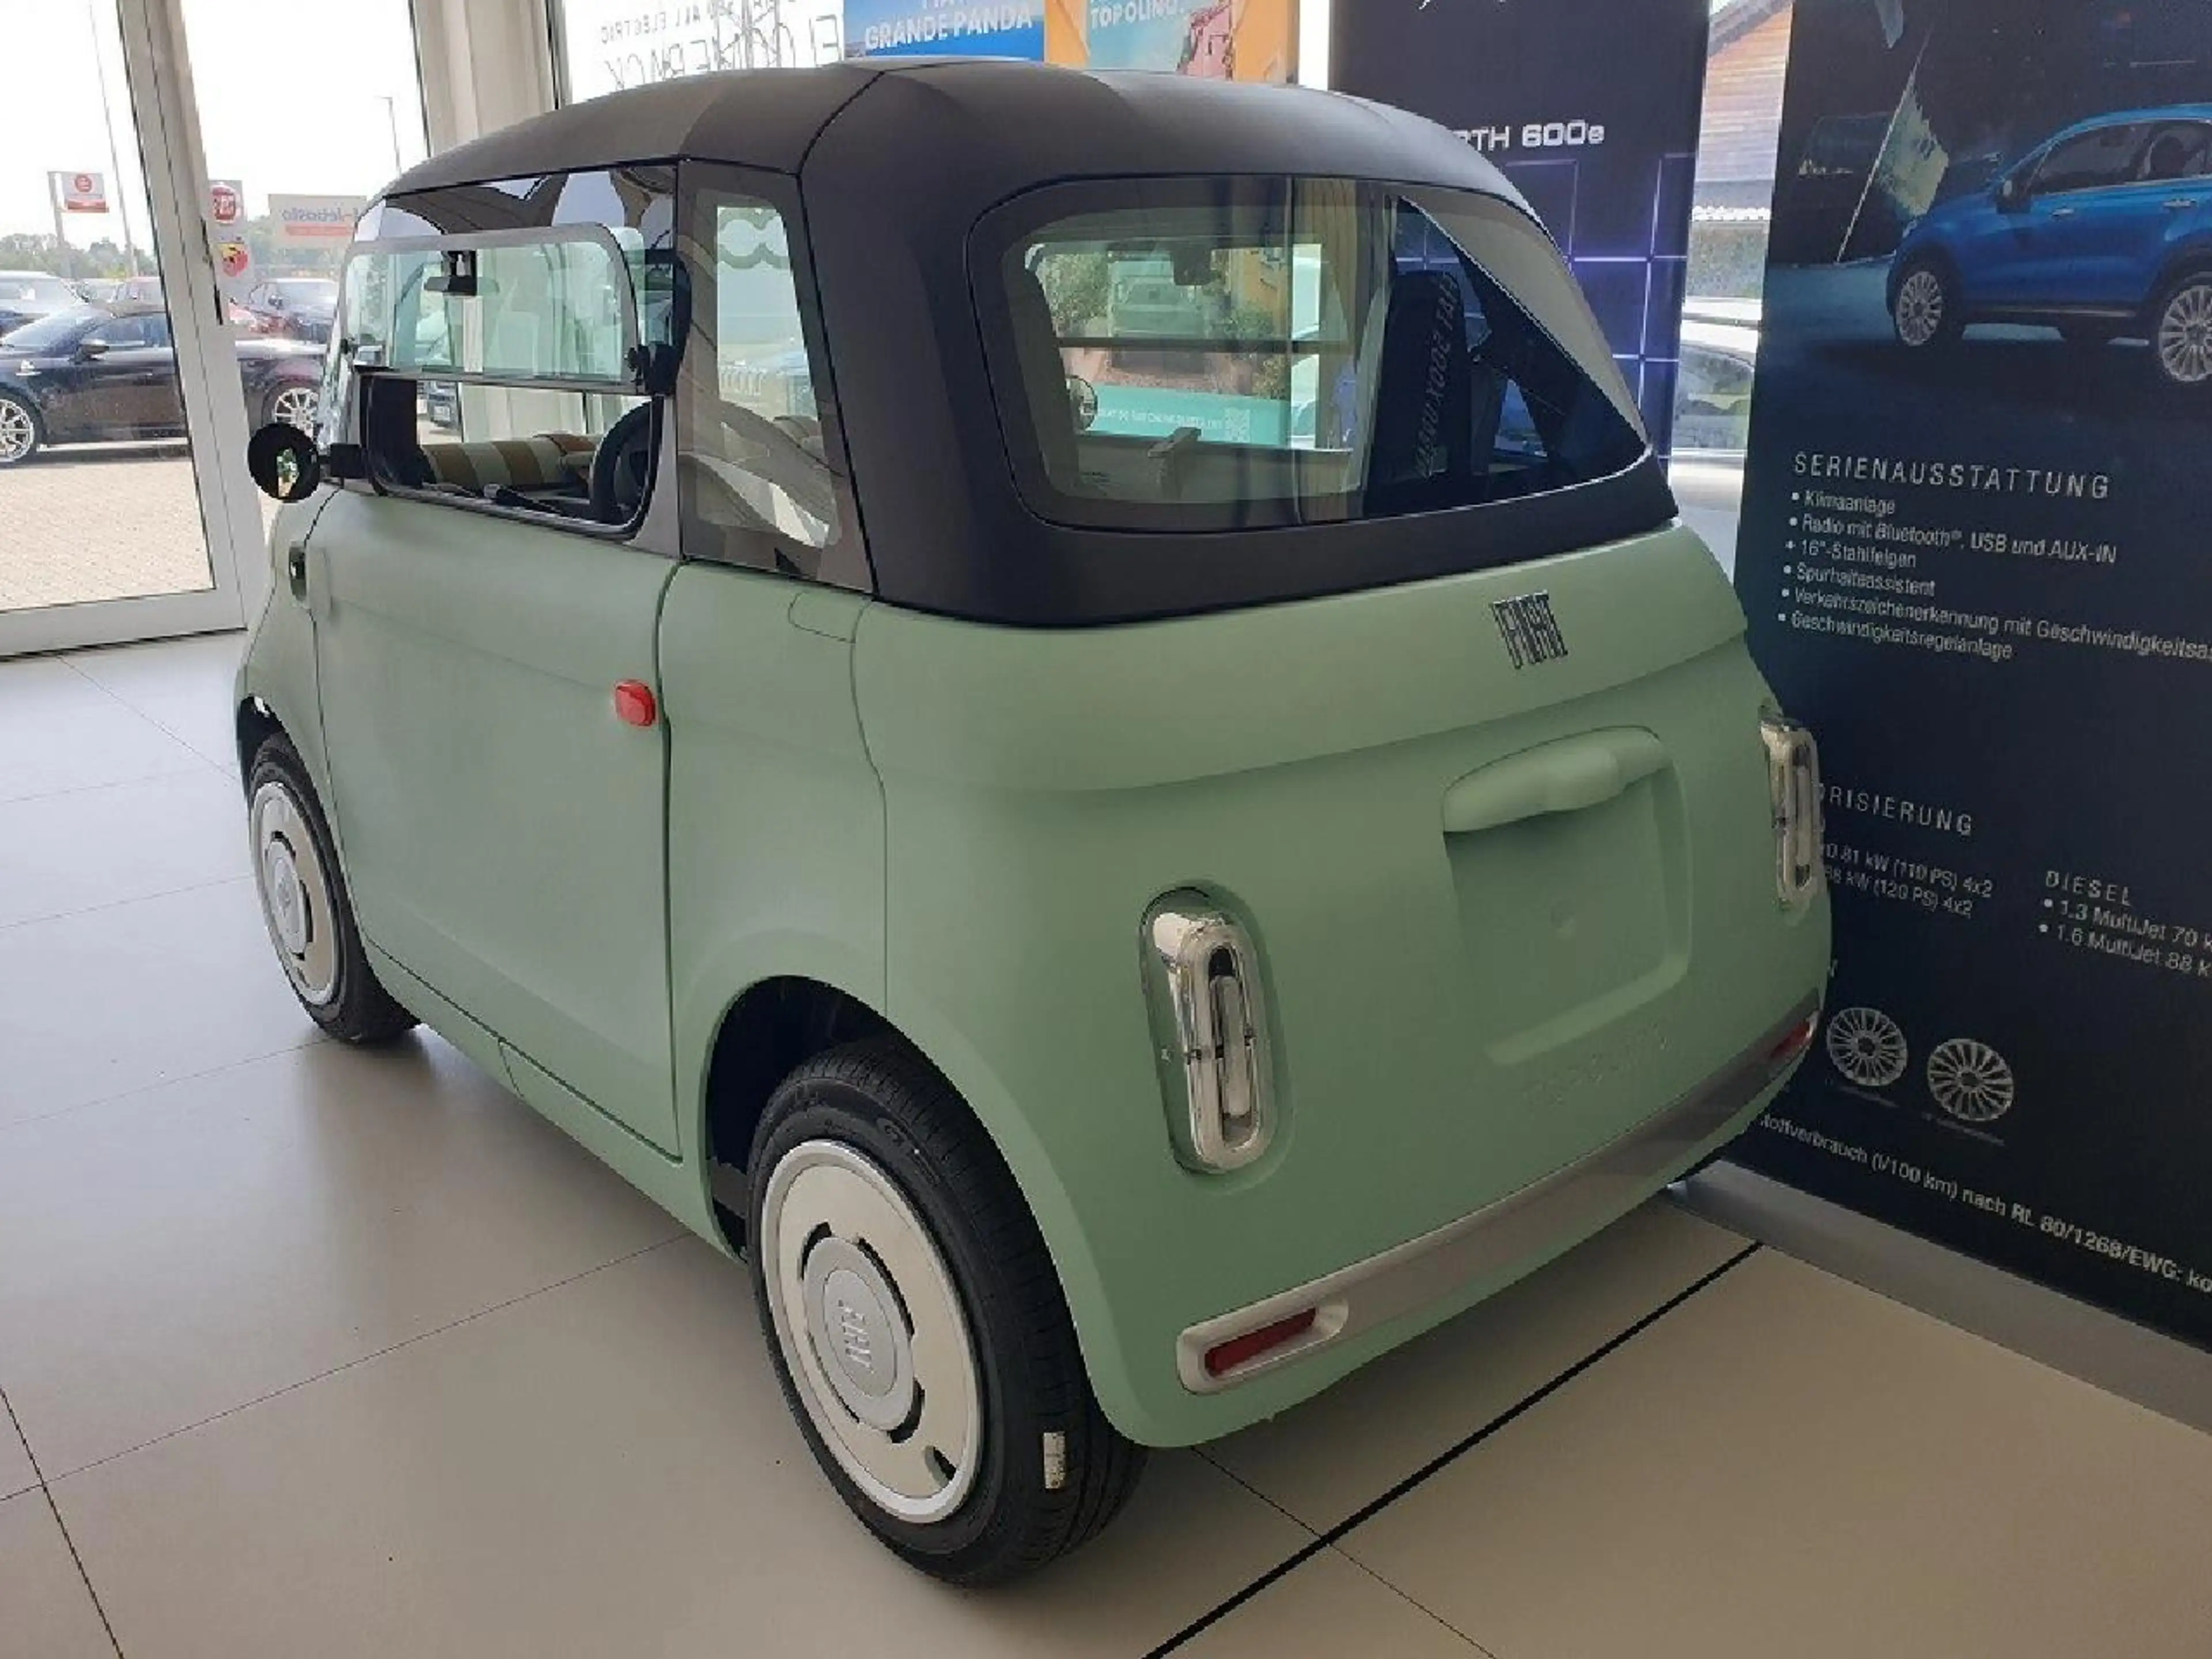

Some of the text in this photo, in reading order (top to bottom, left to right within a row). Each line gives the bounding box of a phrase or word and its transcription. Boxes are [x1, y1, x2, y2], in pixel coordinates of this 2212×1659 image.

[865, 5, 1032, 50] GRANDE PANDA
[1522, 120, 1605, 147] 600e
[1794, 453, 2109, 499] SERIENAUSSTATTUNG
[1804, 490, 1895, 518] Klimaanlage
[1802, 513, 1844, 535] Radio
[1970, 532, 2008, 553] USB
[2012, 539, 2046, 556] und
[2048, 539, 2117, 563] AUX-IN
[2005, 616, 2032, 636] mit
[2046, 870, 2131, 907] DIESEL
[2061, 900, 2088, 921] 1.3
[2172, 926, 2198, 948] 70
[2058, 925, 2083, 946] 1.6
[2165, 952, 2192, 972] 88
[1923, 1172, 1957, 1201] km)
[1963, 1188, 2006, 1217] nach
[2011, 1202, 2035, 1227] RL
